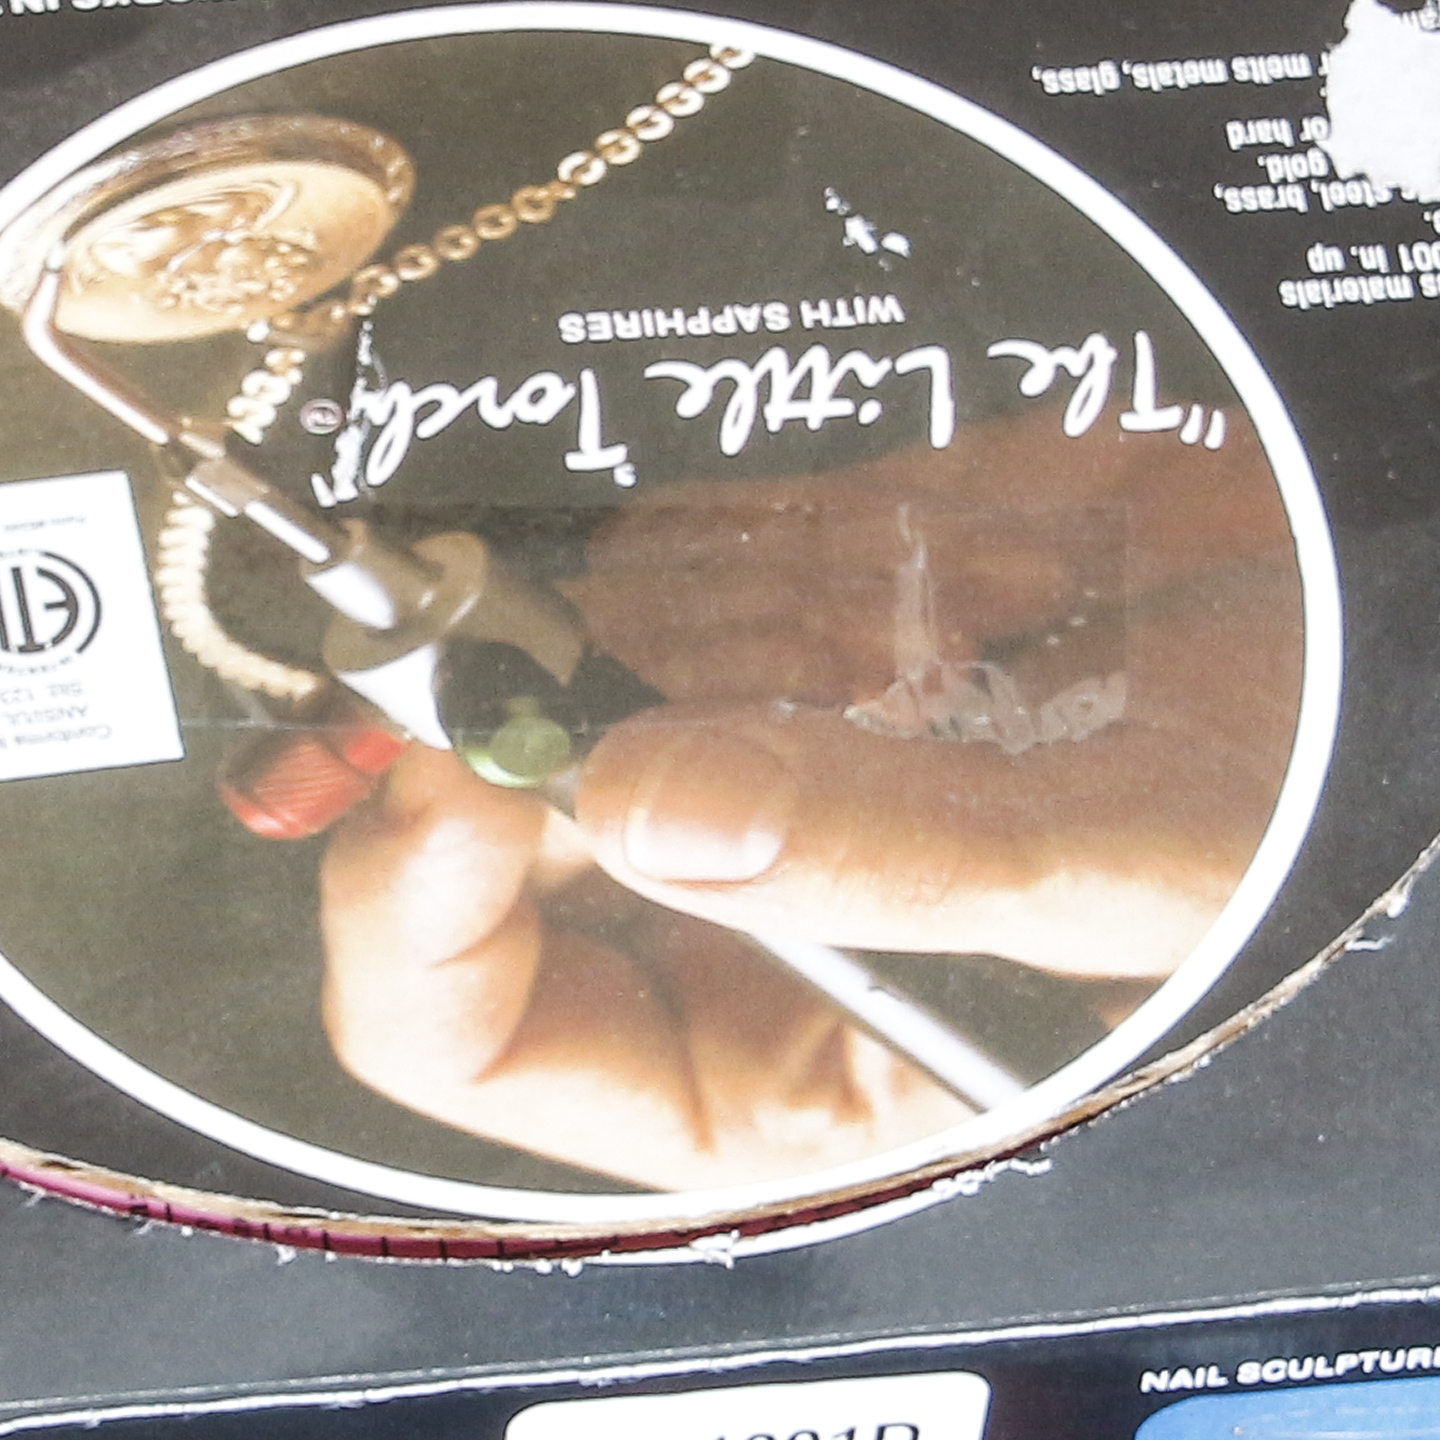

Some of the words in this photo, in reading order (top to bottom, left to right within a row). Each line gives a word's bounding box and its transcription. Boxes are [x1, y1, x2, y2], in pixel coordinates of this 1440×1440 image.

[1031, 59, 1120, 97] glass,
[1121, 51, 1227, 91] metals,
[1231, 51, 1311, 84] melts
[1225, 116, 1293, 149] hard
[1256, 146, 1328, 180] gold.
[1213, 176, 1306, 216] brass,
[1306, 241, 1344, 273] up
[1350, 243, 1388, 271] in.
[1278, 271, 1413, 310] materials
[558, 298, 789, 345] SAPPHIRES
[799, 293, 903, 328] WITH
[643, 335, 957, 467] Little
[1140, 1365, 1229, 1393] NAIL
